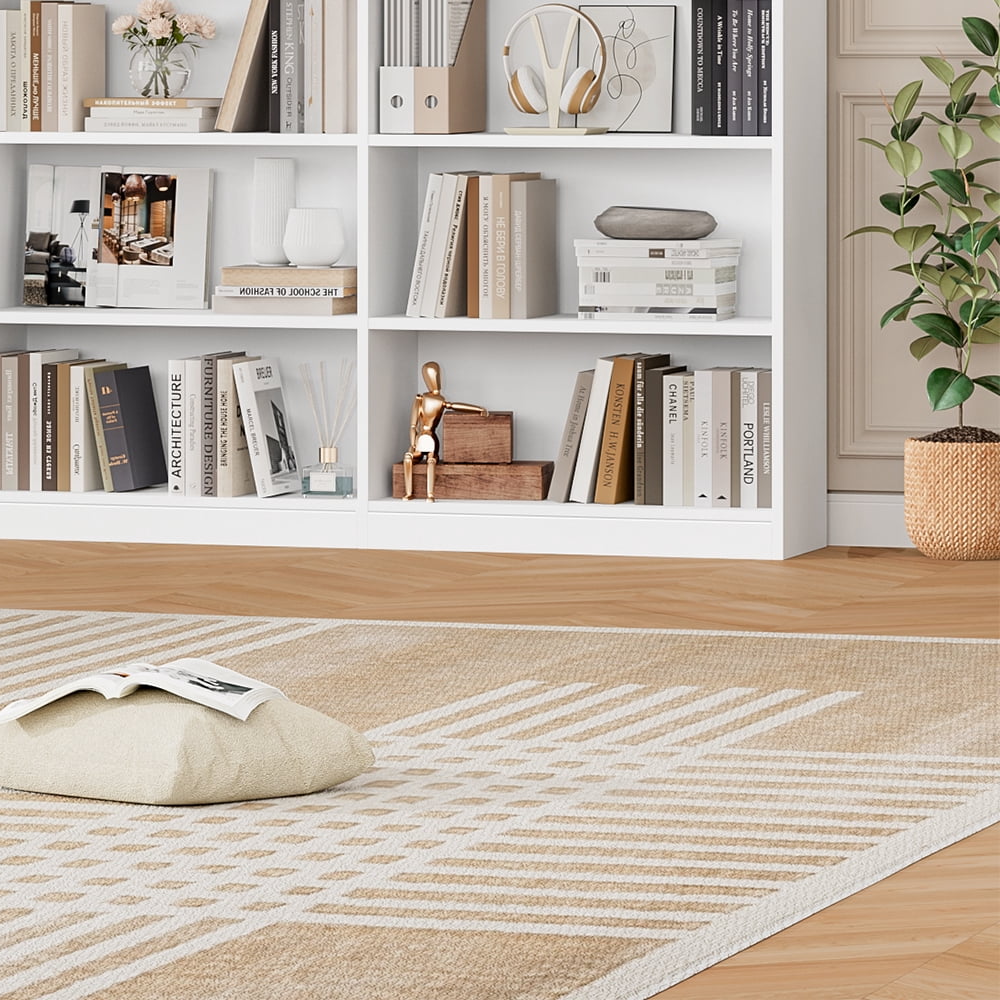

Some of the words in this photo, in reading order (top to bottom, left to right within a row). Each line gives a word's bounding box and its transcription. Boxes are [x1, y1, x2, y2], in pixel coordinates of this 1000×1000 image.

[284, 42, 294, 74] KING
[697, 56, 703, 65] TO
[496, 217, 505, 229] НЕ
[496, 231, 505, 253] БЕРИ
[496, 264, 505, 299] ГОЛОВУ
[203, 358, 213, 440] FURNITURE
[669, 384, 677, 424] CHANEL
[171, 373, 182, 478] ARCHITECTURE
[246, 408, 255, 432] MARCEL
[249, 433, 260, 456] BREUER
[744, 423, 754, 484] PORTLAND
[203, 444, 213, 496] DESIGN
